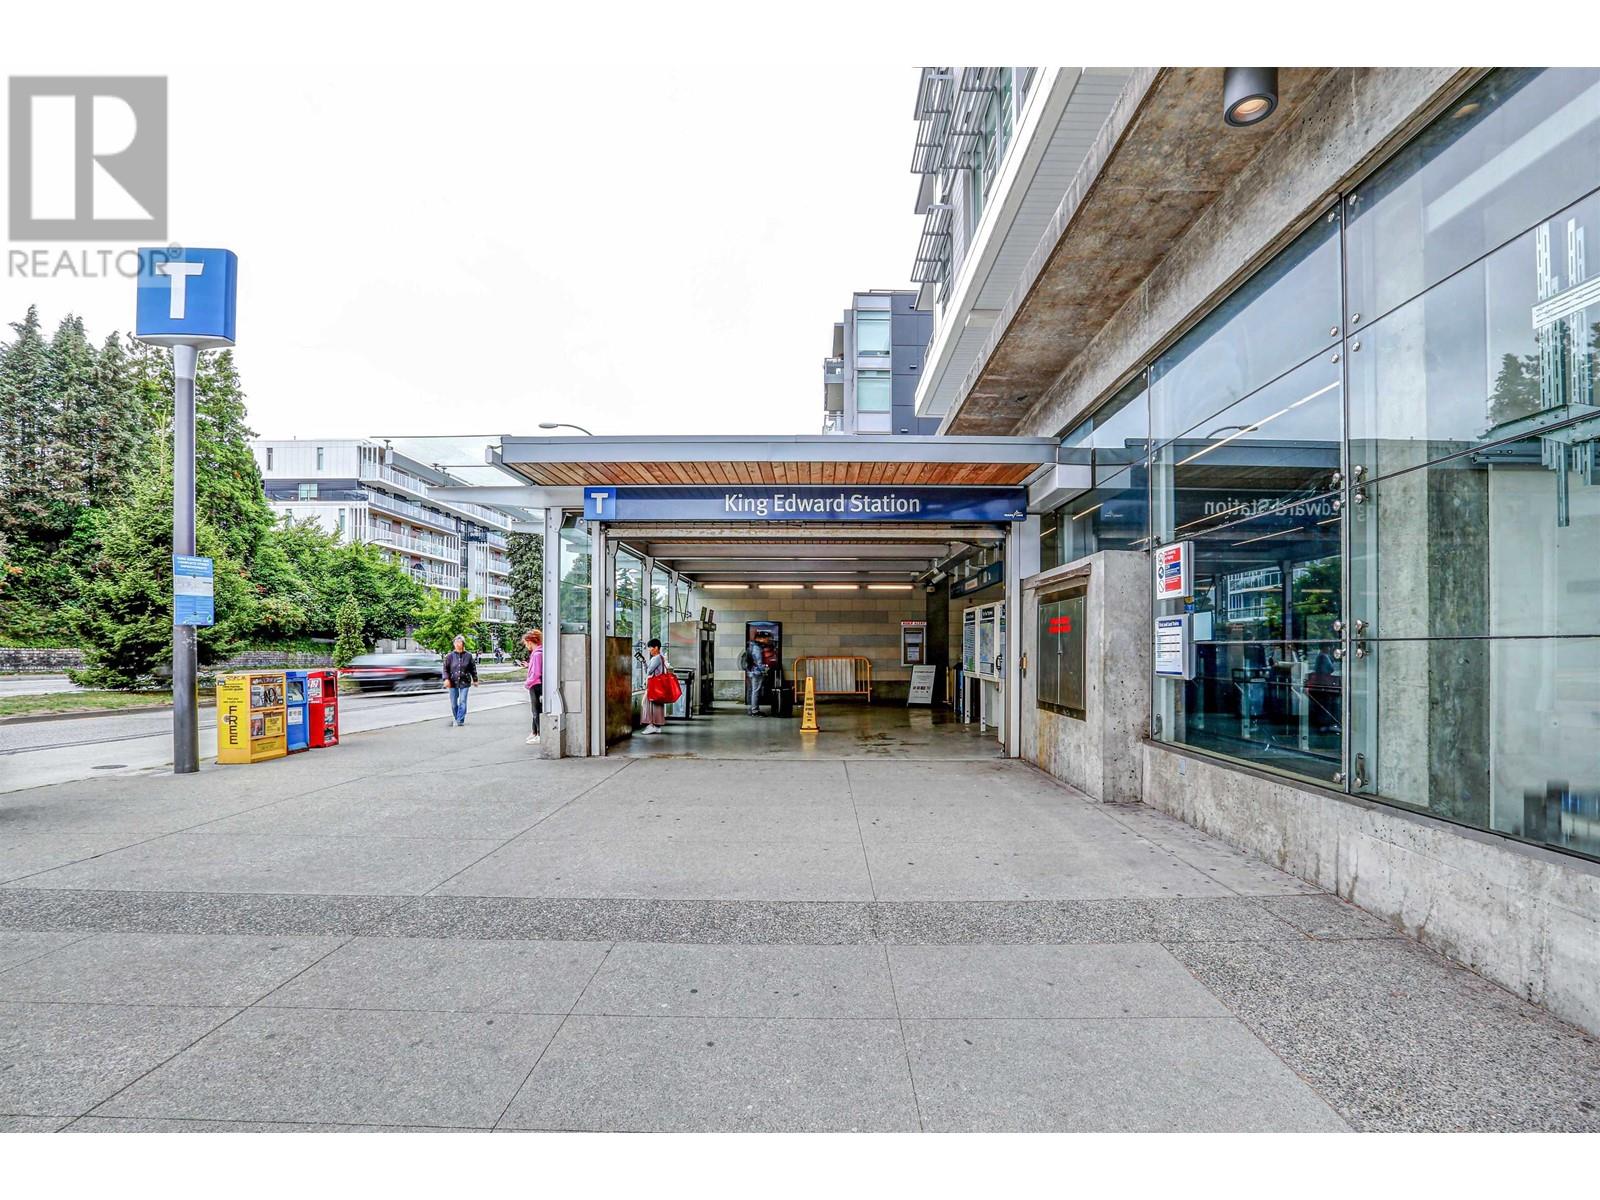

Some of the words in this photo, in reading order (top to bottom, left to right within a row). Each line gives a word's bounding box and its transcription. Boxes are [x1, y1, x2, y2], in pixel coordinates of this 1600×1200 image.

[155, 262, 204, 319] T
[590, 493, 609, 514] T
[724, 494, 769, 516] King
[774, 494, 844, 513] Edward
[850, 494, 921, 513] Station
[229, 705, 238, 745] FREE
